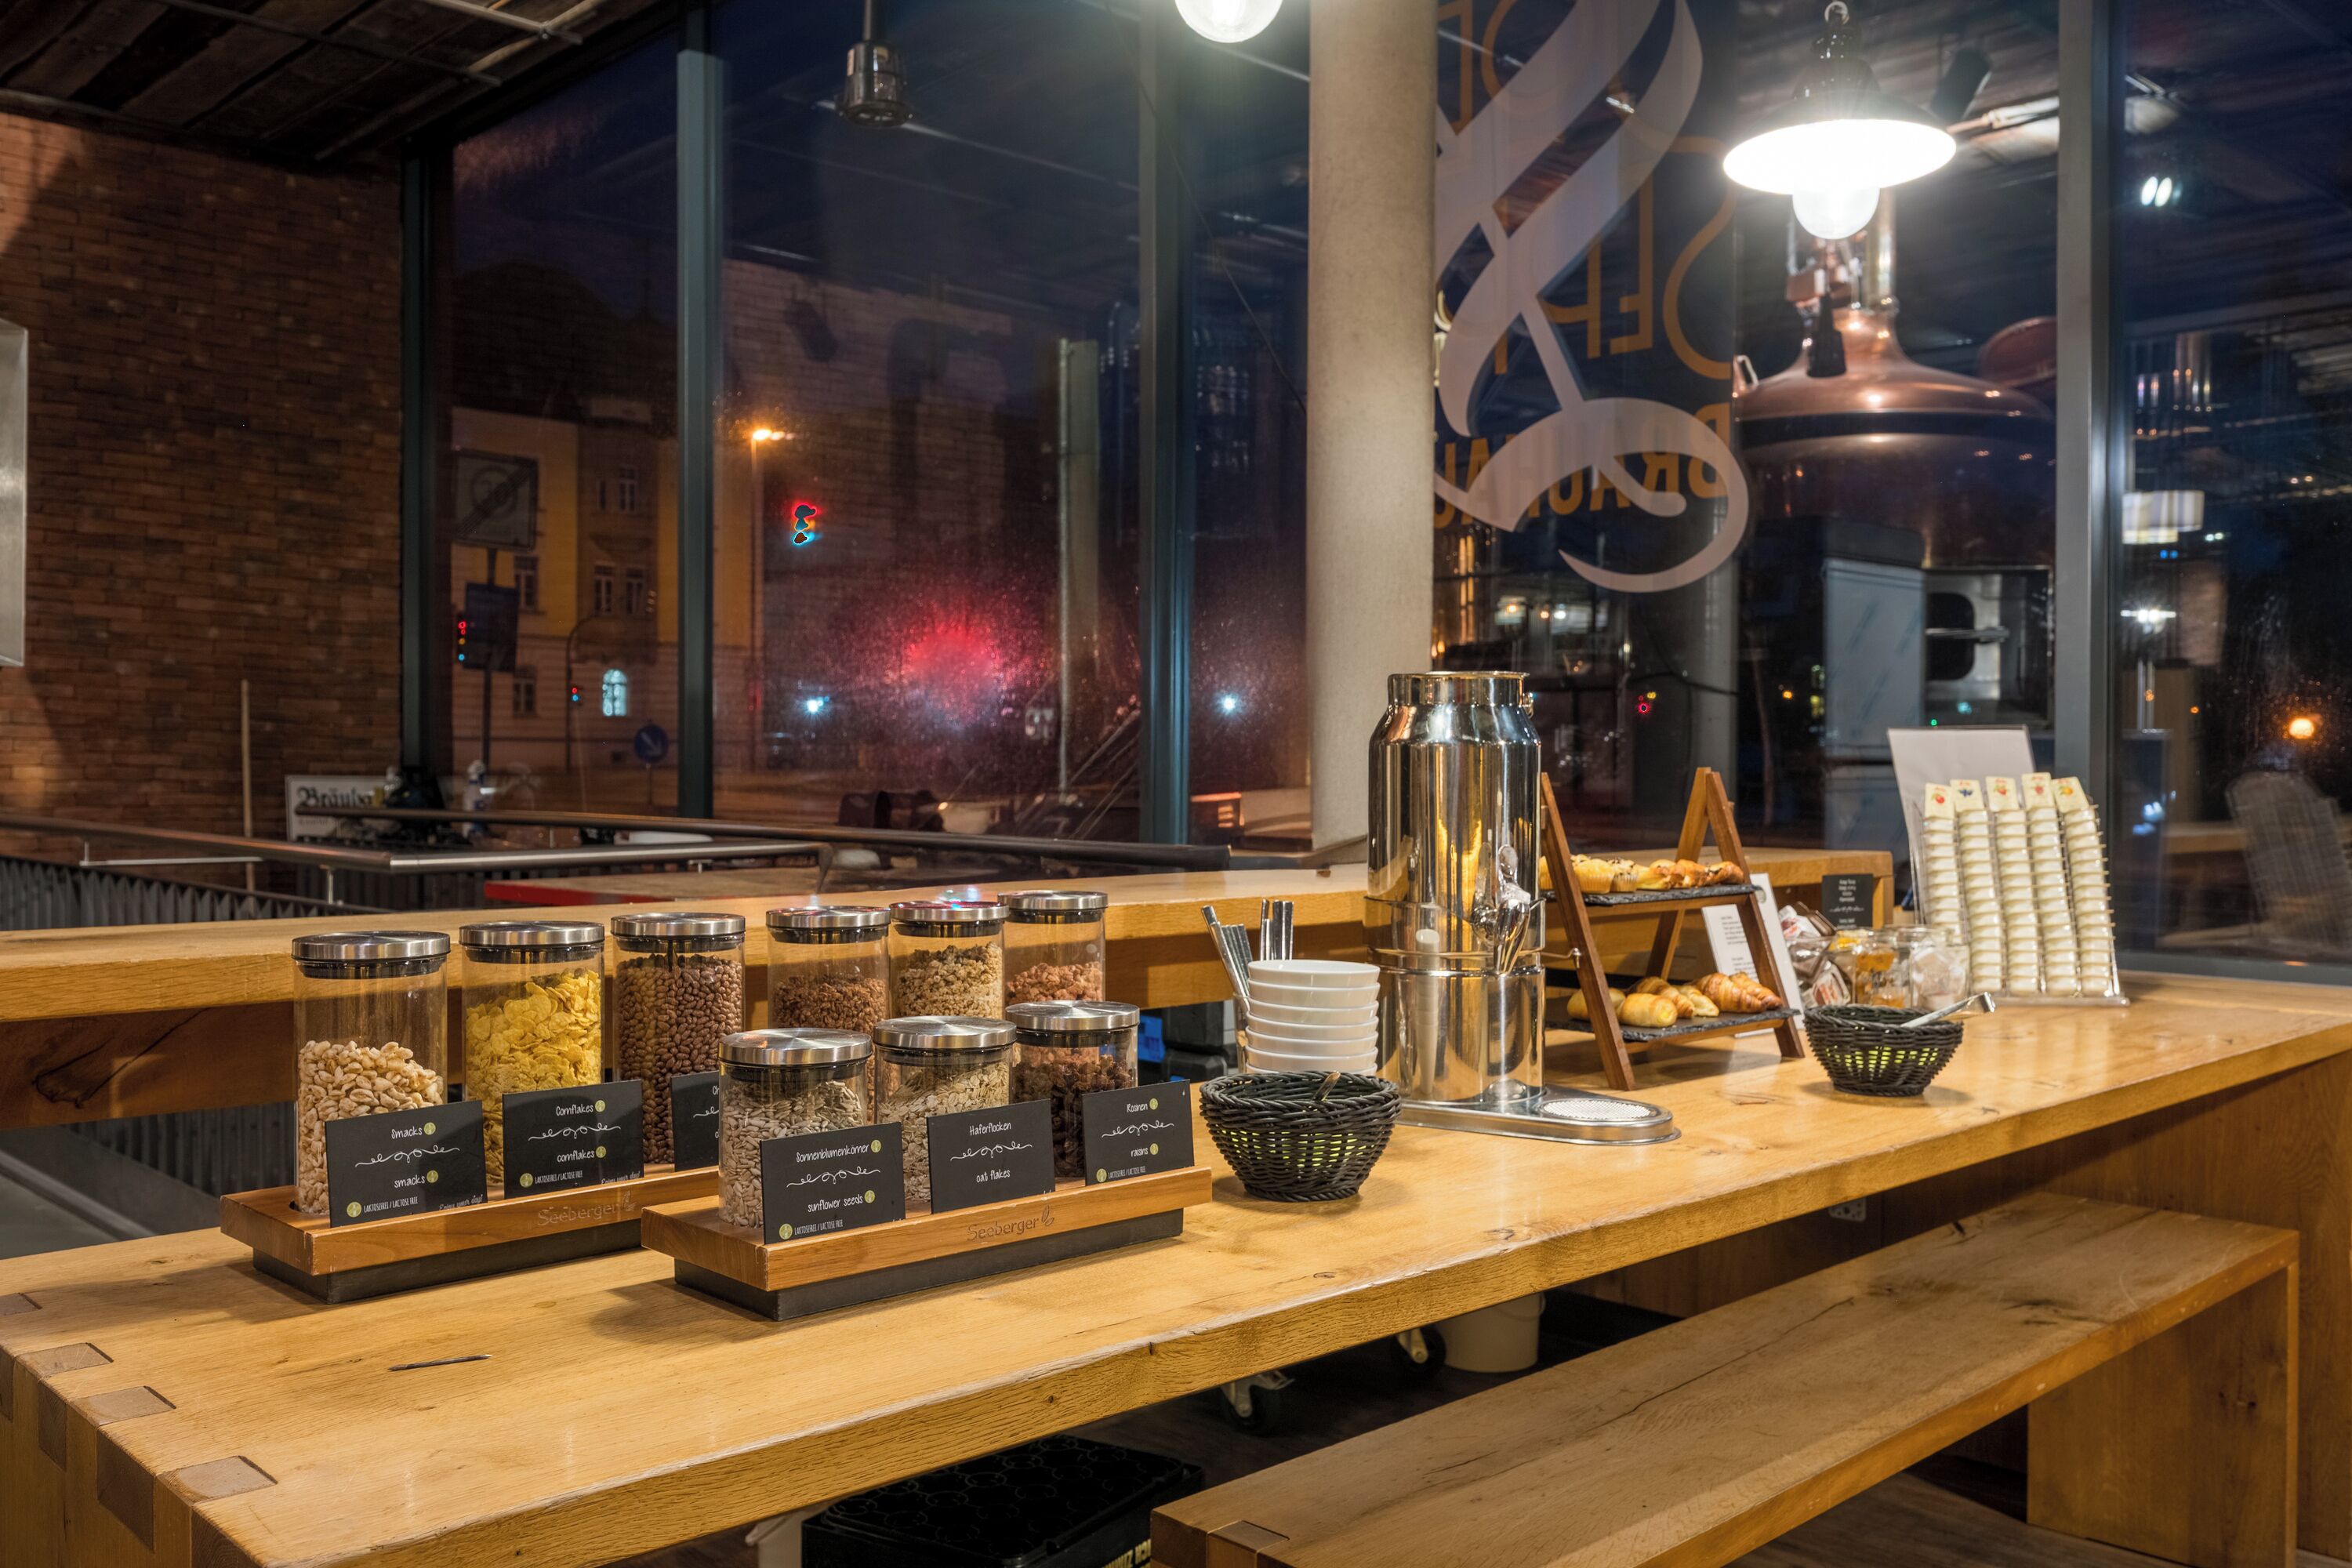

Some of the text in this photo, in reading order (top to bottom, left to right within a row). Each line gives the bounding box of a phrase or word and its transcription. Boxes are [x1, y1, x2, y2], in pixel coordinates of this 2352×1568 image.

[556, 1104, 593, 1116] Cornflakes
[1127, 1102, 1149, 1113] Rosinen
[391, 1126, 423, 1140] Smacks
[969, 1121, 1012, 1136] Haferflocken
[557, 1150, 595, 1163] cornflakes
[796, 1144, 869, 1163] Sonnenblumenkörner
[1131, 1147, 1149, 1158] raisins
[394, 1174, 426, 1189] smacks
[976, 1169, 1011, 1183] oat flakes
[364, 1201, 389, 1213] LAKTOSEFREI
[392, 1197, 409, 1208] LACTOSE
[808, 1194, 863, 1213] sunflower seeds
[538, 1203, 621, 1226] Seeberger
[794, 1223, 817, 1236] LAKTOSEFREI
[820, 1221, 836, 1231] LACTOSE
[835, 1219, 844, 1229] FREE
[967, 1217, 1040, 1242] Seeberger
